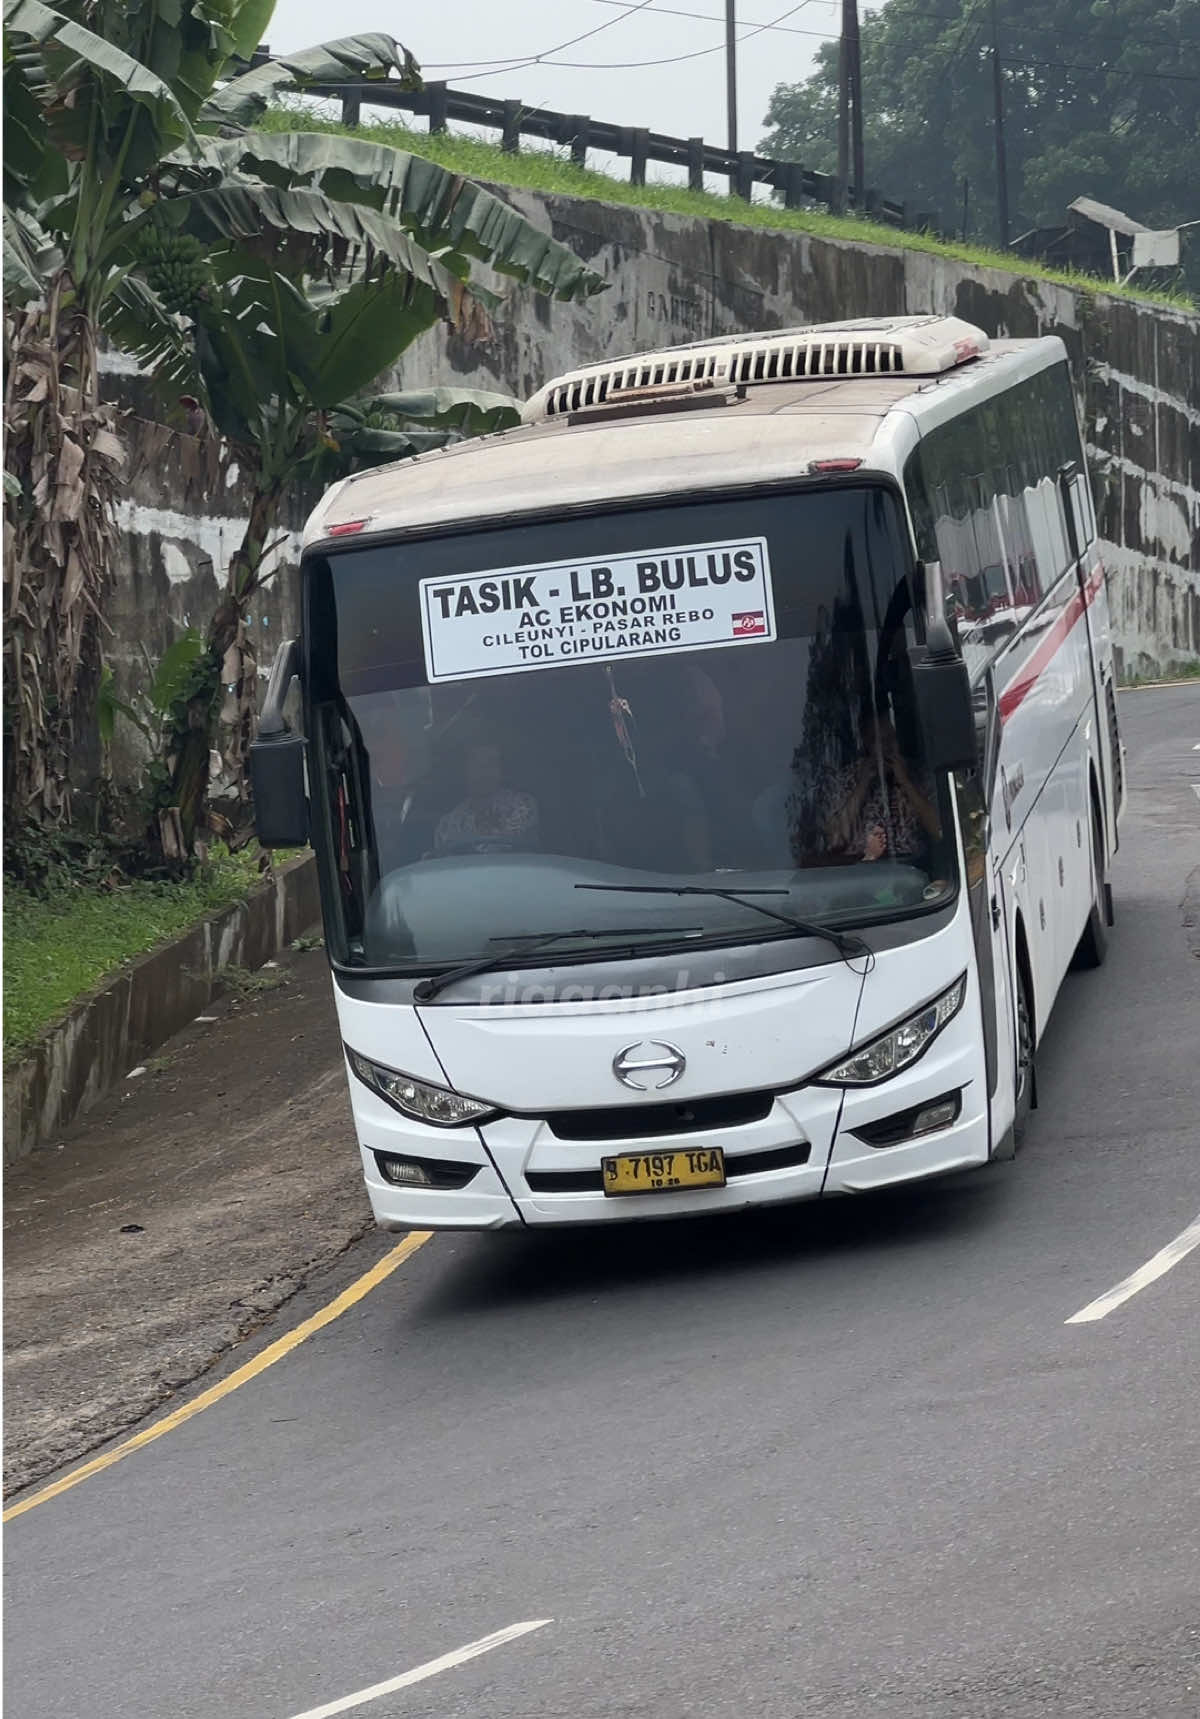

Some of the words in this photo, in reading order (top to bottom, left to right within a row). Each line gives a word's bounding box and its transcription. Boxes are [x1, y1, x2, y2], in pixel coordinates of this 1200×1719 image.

[433, 576, 540, 619] TASIK
[570, 567, 626, 602] LB.
[636, 550, 756, 594] BULUS
[482, 625, 574, 647] CILEUNYI
[593, 615, 656, 634] PASAR
[662, 608, 714, 625] REBO
[519, 609, 552, 629] AC
[560, 594, 676, 624] EKONOMI
[518, 643, 555, 659] TOL
[560, 627, 681, 655] CIPULARANG
[629, 1155, 675, 1179] 7197
[685, 1150, 722, 1174] TGA
